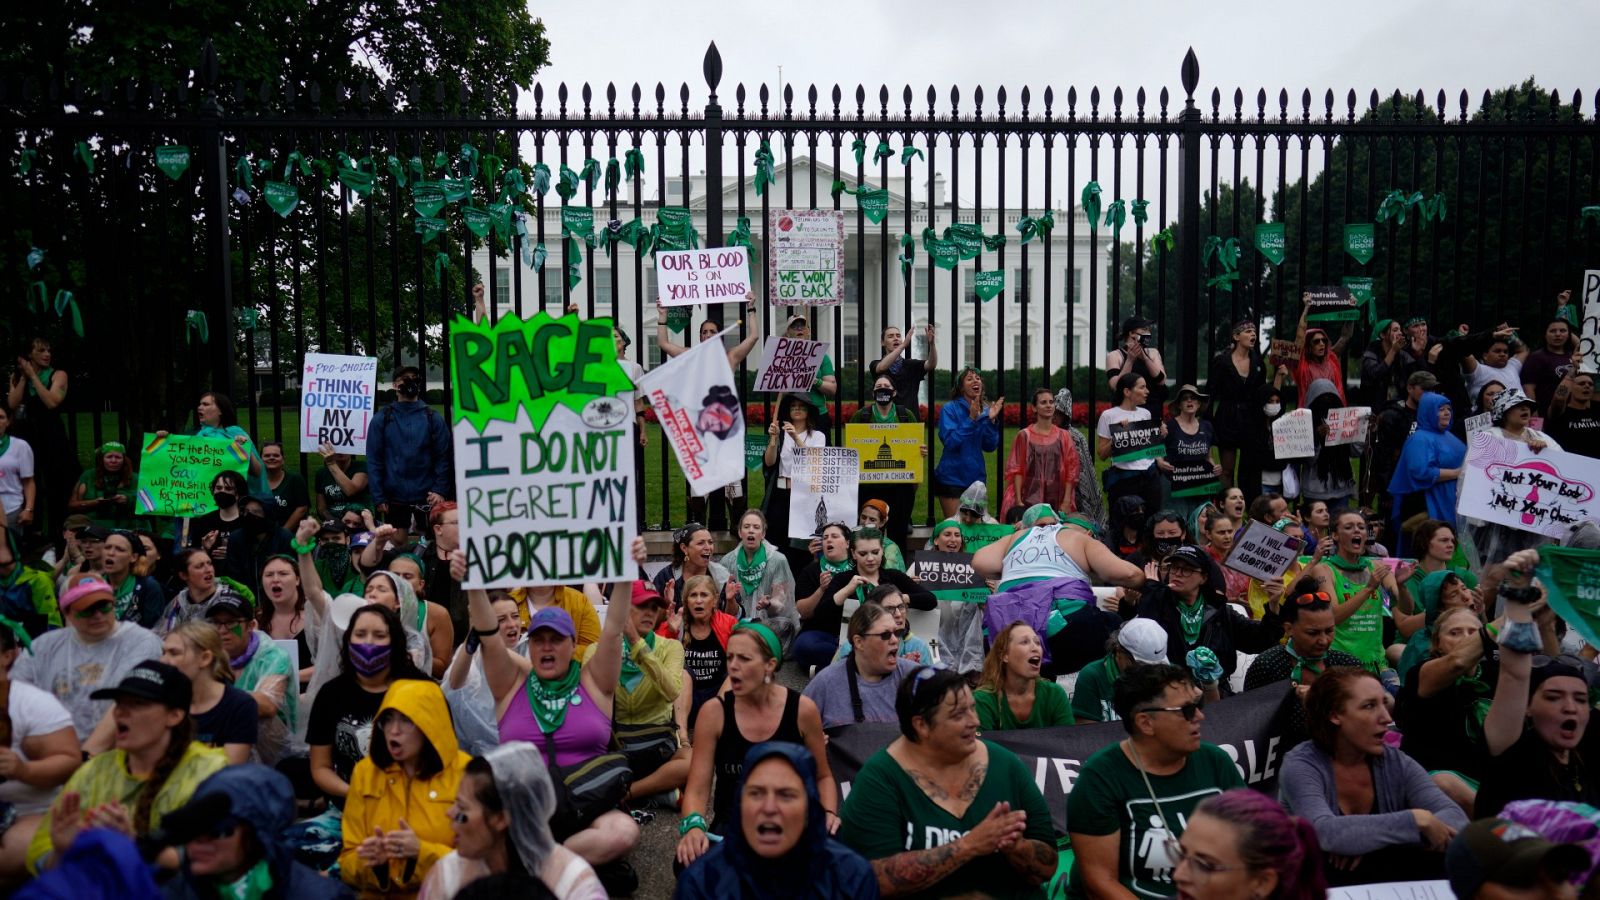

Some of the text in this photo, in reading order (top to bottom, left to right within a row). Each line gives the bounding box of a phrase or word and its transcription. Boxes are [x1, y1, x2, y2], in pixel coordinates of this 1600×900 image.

[661, 252, 743, 271] OUR BLOOD
[688, 270, 721, 281] IS ON
[778, 271, 800, 283] WE
[667, 282, 745, 300] YOUR HANDS
[780, 283, 832, 298] GO BACK
[774, 338, 822, 357] PUBLIC
[315, 362, 375, 375] PRO-CHOICE
[453, 324, 613, 412] RAGE
[766, 364, 817, 374] ANNOUNCEMENT
[772, 356, 809, 368] CERVIX
[316, 378, 362, 394] THINK
[760, 371, 815, 391] FUCK YOU!
[304, 393, 372, 411] OUTSIDE
[323, 409, 352, 428] MY
[318, 427, 355, 447] BOX
[1114, 427, 1160, 440] WE WON'T
[188, 444, 201, 454] the
[1114, 437, 1152, 448] GO BACK
[465, 430, 625, 478] I DO NOT
[170, 466, 198, 480] Gay
[1173, 473, 1214, 481] Ungovernab
[1503, 471, 1525, 484] Not
[1529, 473, 1558, 490] Your
[150, 477, 168, 487] will
[810, 485, 840, 493] RESIST
[160, 489, 170, 501] for
[466, 476, 628, 528] REGRET MY
[1495, 494, 1517, 510] Not
[1521, 500, 1548, 517] Your
[1261, 535, 1283, 551] I WILL
[463, 526, 624, 584] ABORTION
[1010, 546, 1067, 568] ROAR
[1241, 541, 1289, 566] AID AND ABET
[919, 561, 975, 574] WE WON
[1237, 553, 1278, 575] ABORTION
[919, 572, 974, 585] GO BACK
